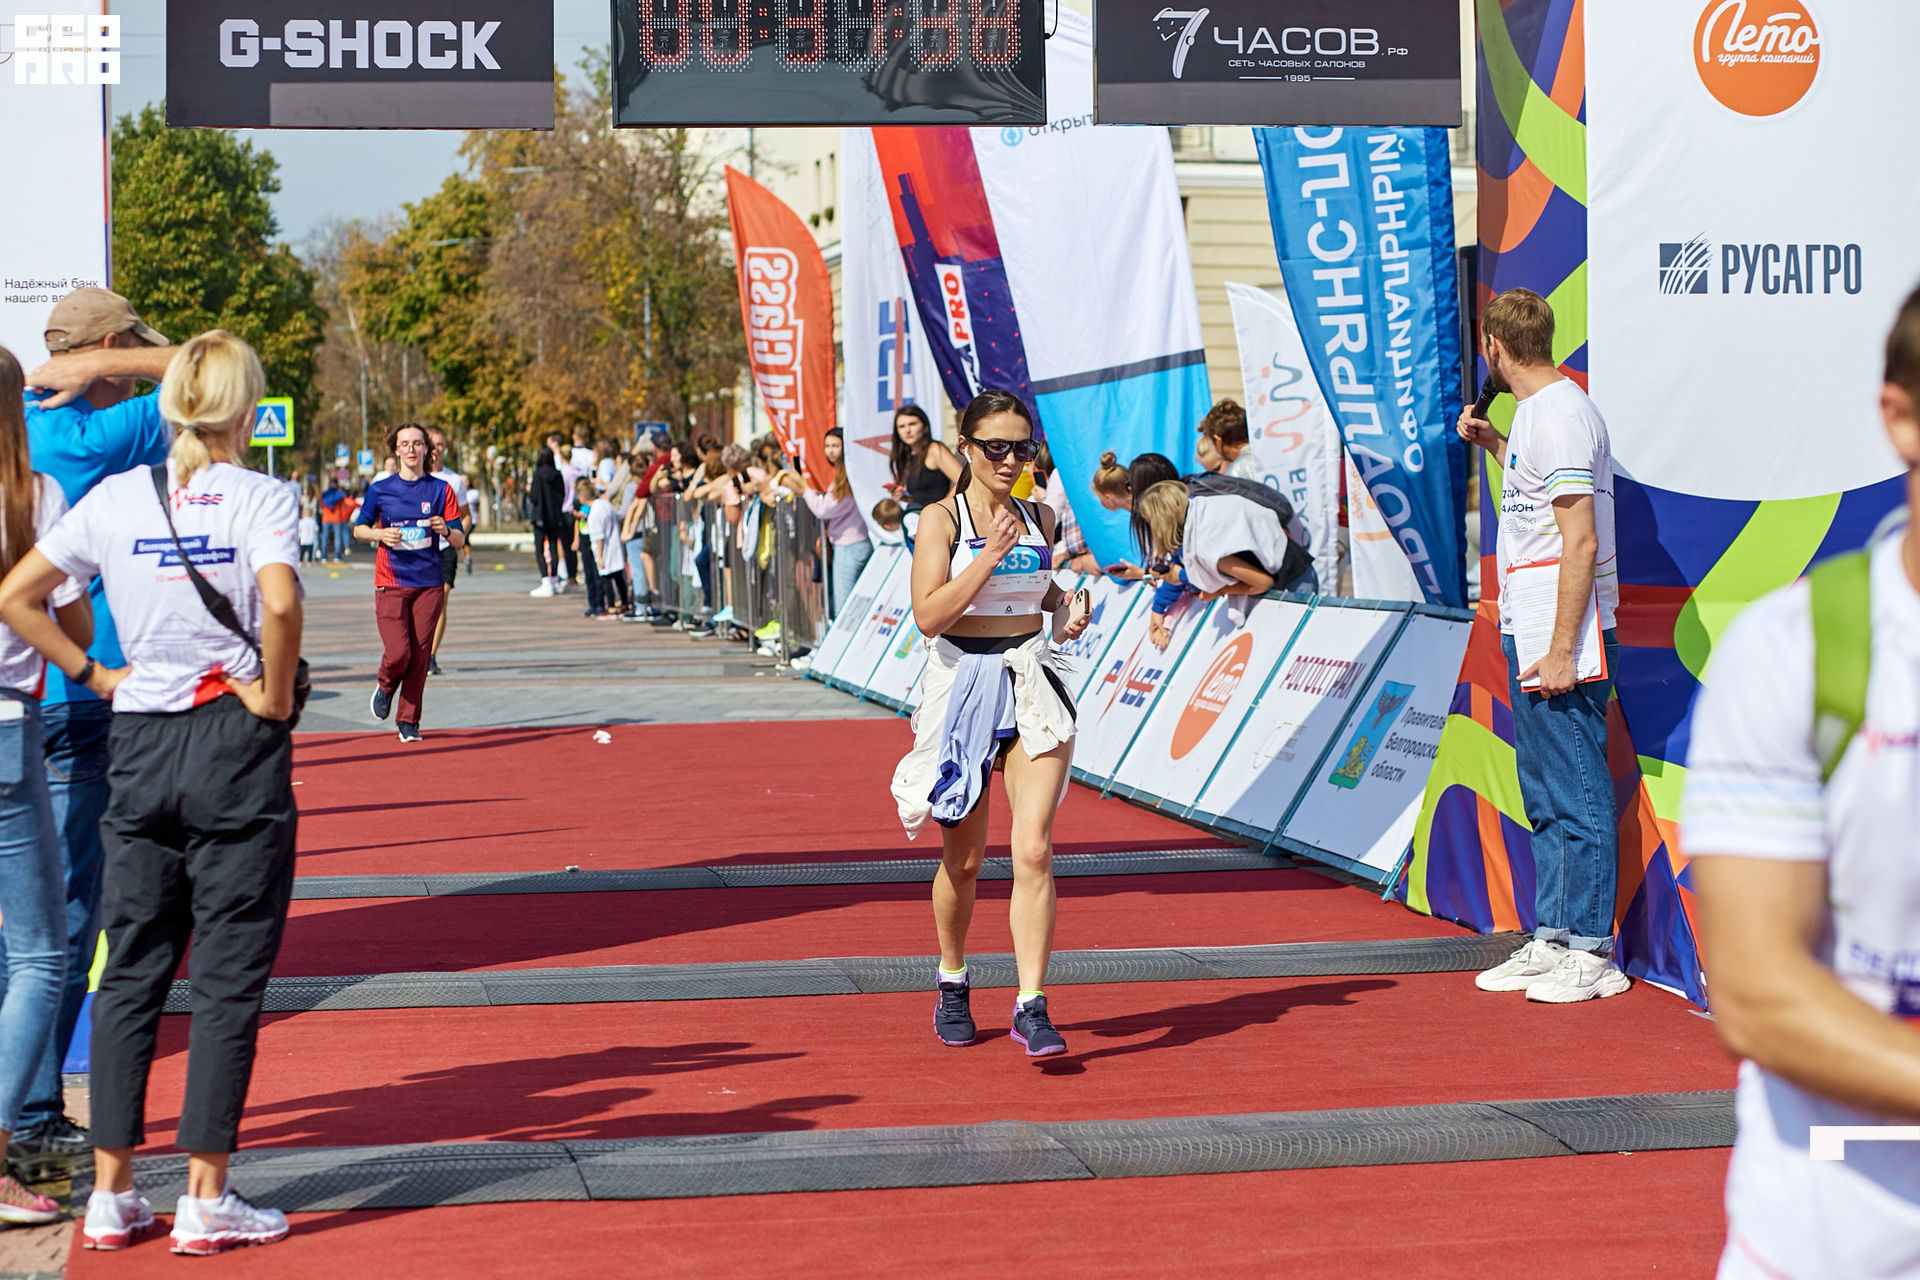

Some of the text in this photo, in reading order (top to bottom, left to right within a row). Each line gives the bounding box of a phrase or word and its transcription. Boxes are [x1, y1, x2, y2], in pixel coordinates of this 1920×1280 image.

[219, 18, 502, 69] G-SHOCK
[1702, 0, 1820, 63] Лето
[1228, 59, 1366, 68] СЕТЬ ЧАСОВЫХ САЛОНОВ
[1717, 52, 1816, 67] группа компаний
[1284, 74, 1311, 82] 1995
[4, 277, 99, 290] Надёжный банк
[1721, 243, 1862, 295] РУСАГРО
[4, 294, 49, 303] нашего
[943, 272, 970, 341] PRO
[1189, 644, 1246, 706] Лето
[1279, 655, 1367, 699] РОСГОССТРАХ
[1370, 759, 1407, 783] области
